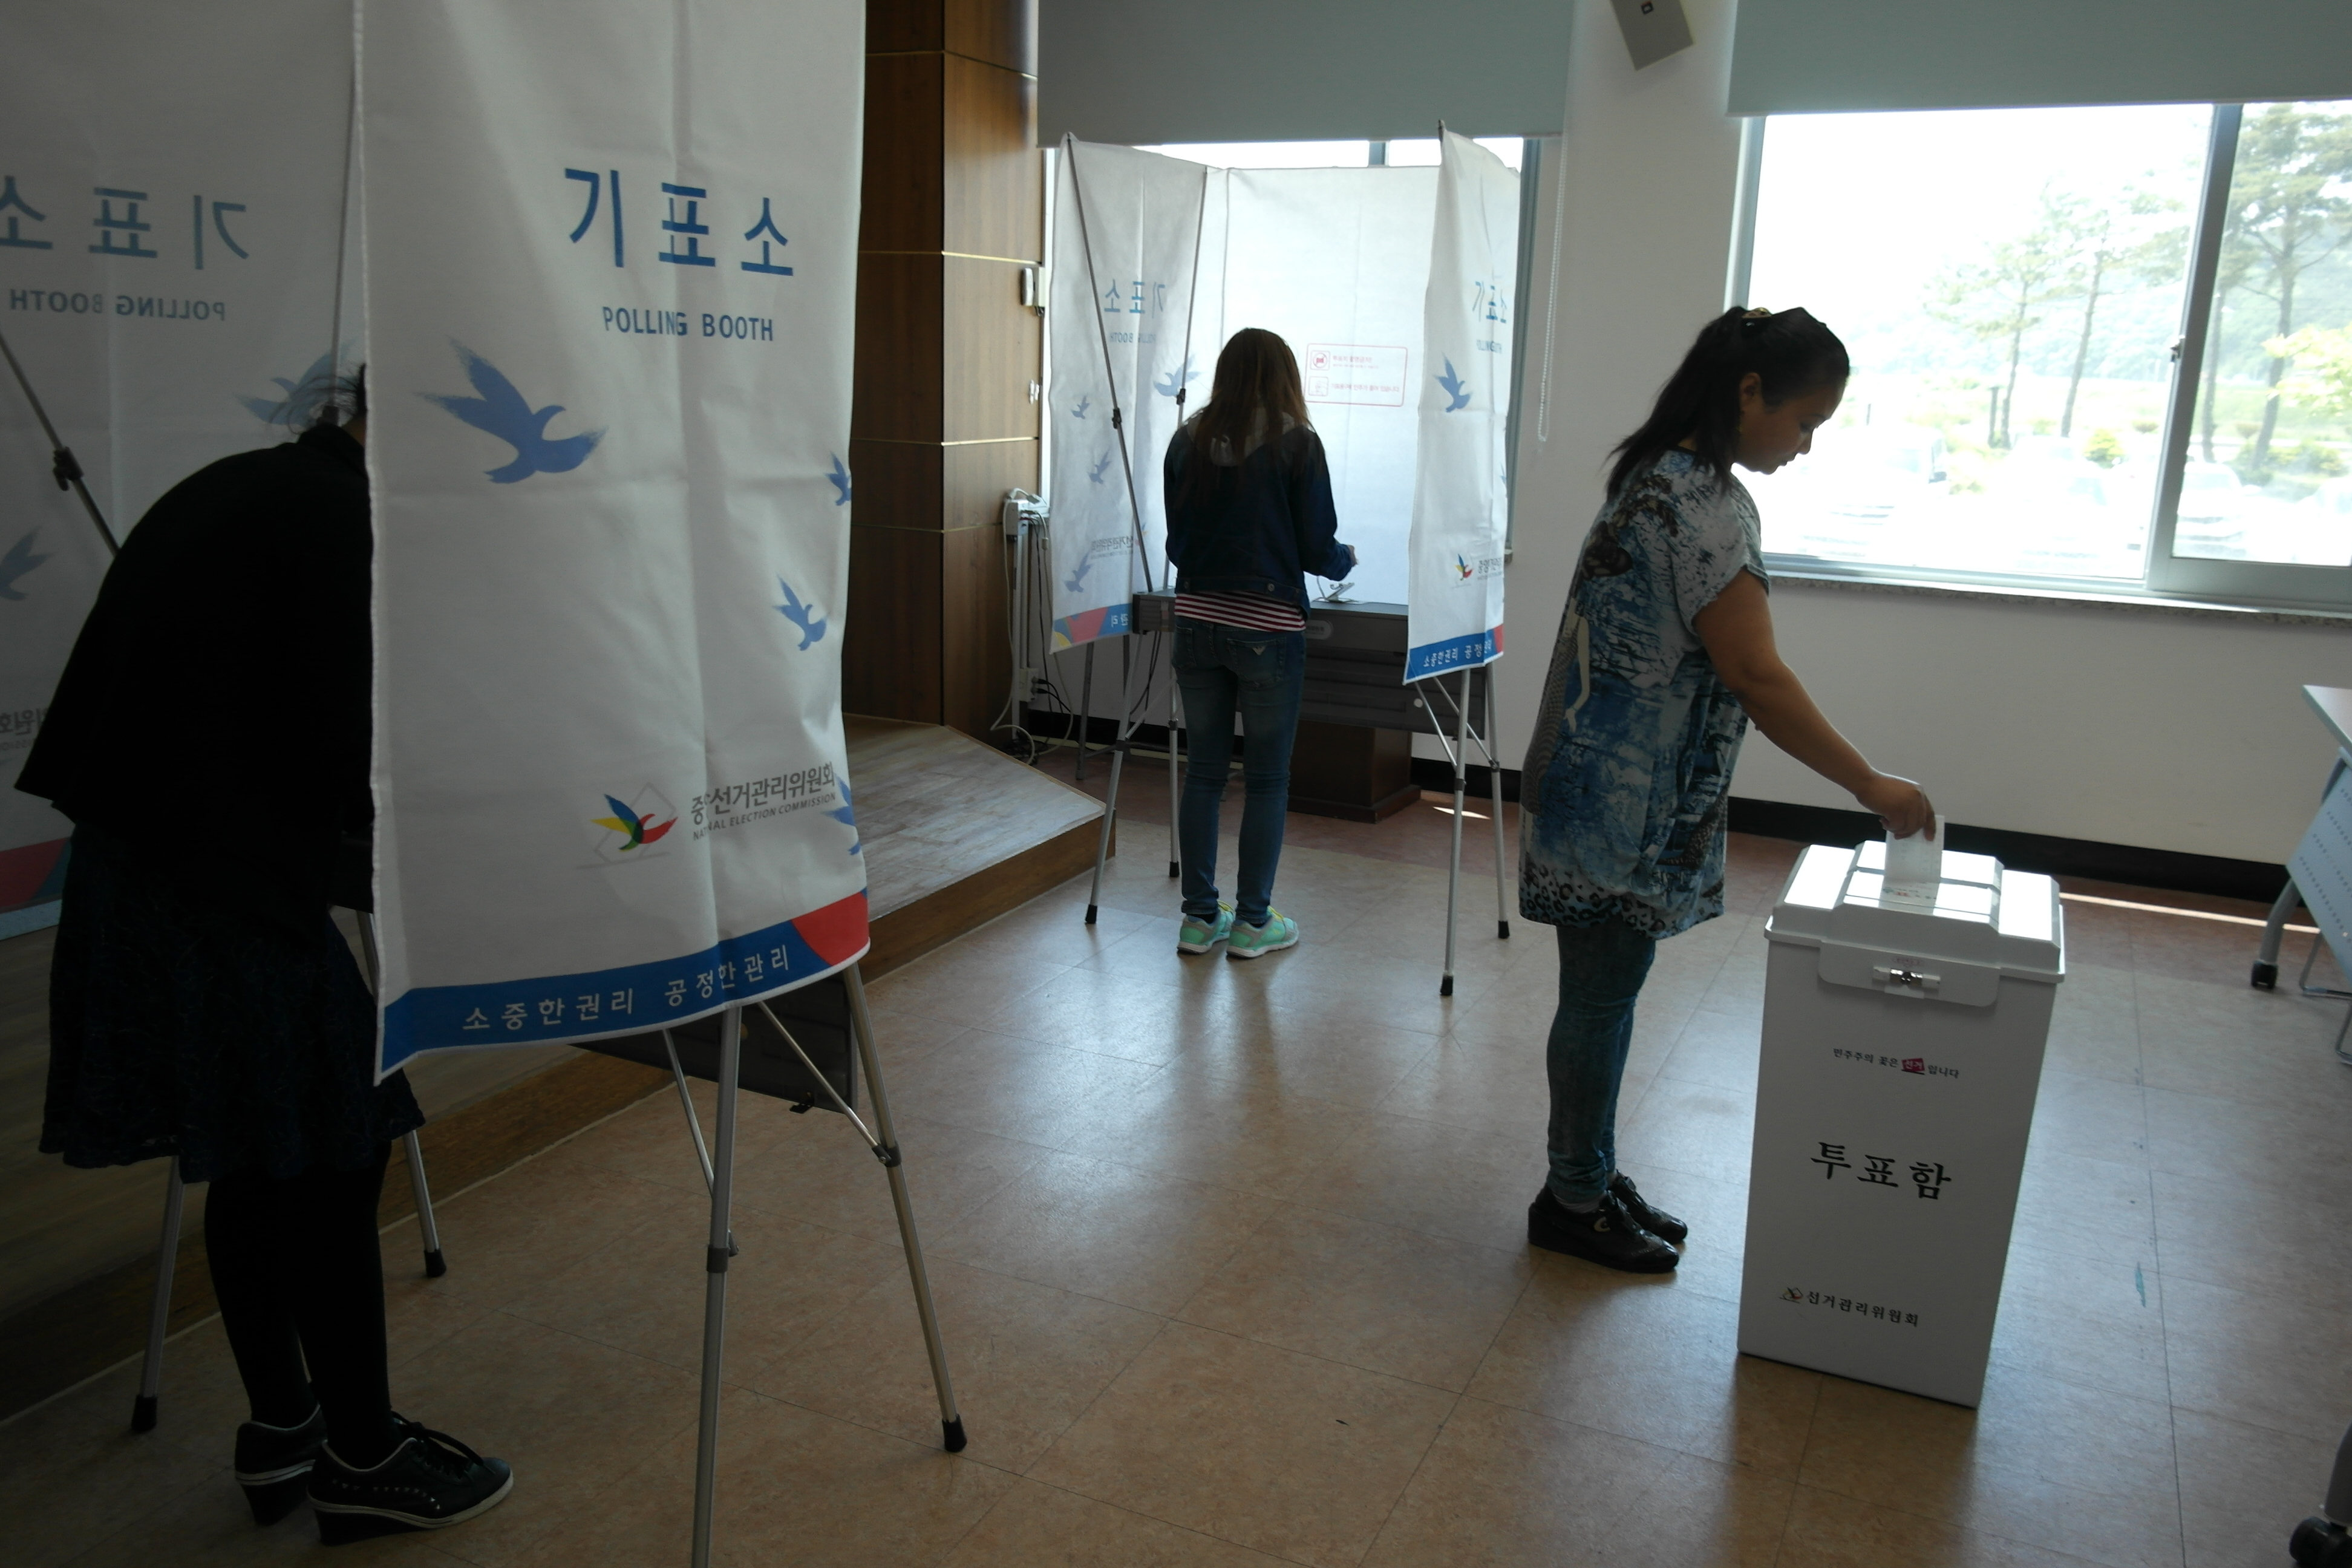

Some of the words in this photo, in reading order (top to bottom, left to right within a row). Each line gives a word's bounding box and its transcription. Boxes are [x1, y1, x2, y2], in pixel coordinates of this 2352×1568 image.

[565, 168, 794, 276] 기표소
[603, 305, 687, 336] POLLING
[702, 313, 774, 342] BOOTH
[691, 761, 835, 825] 중선거관리위원회
[729, 807, 776, 827] ELECTION
[778, 792, 836, 814] COMMISSION
[1833, 1048, 1874, 1064] 민주주의
[1810, 1141, 1952, 1200] 투표함
[1806, 1290, 1919, 1328] 선거관리위원회
